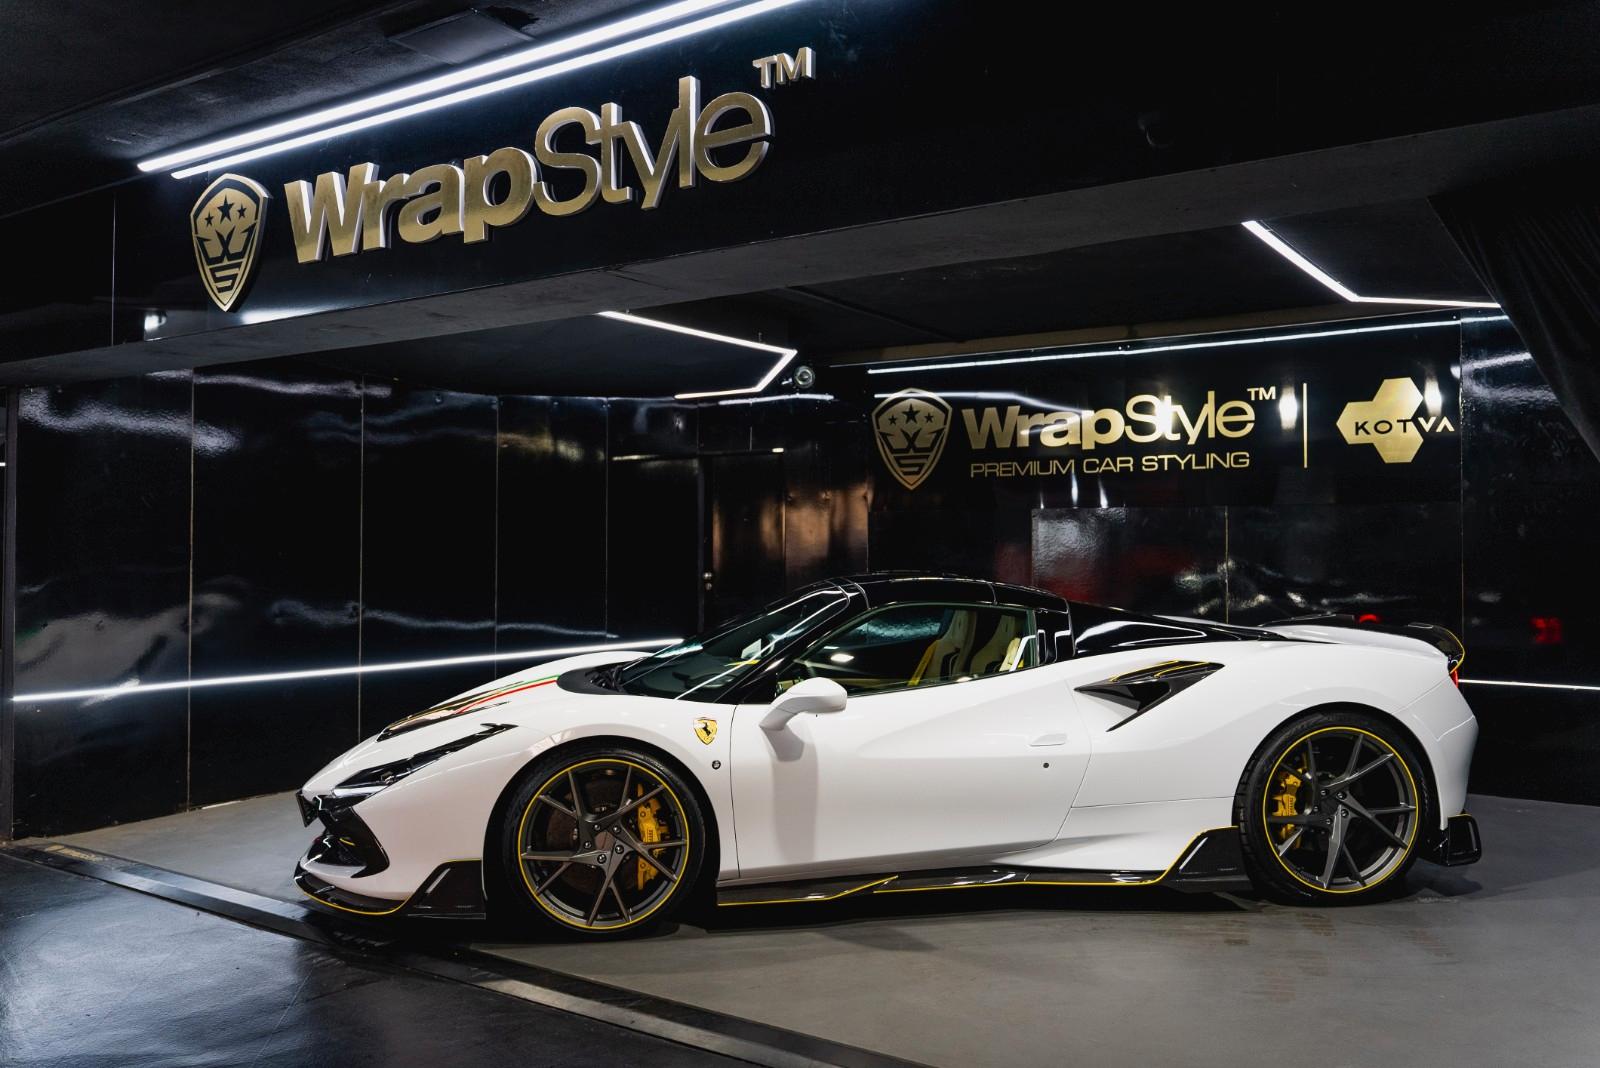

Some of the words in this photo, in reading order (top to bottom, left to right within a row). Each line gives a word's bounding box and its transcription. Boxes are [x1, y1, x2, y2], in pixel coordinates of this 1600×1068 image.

[284, 76, 774, 264] WrapStyle
[962, 391, 1255, 450] WrapStyle
[1355, 416, 1455, 436] KOTVA
[970, 459, 1075, 478] PREMIUM
[1083, 457, 1134, 474] CAR
[1142, 453, 1251, 471] STYLING
